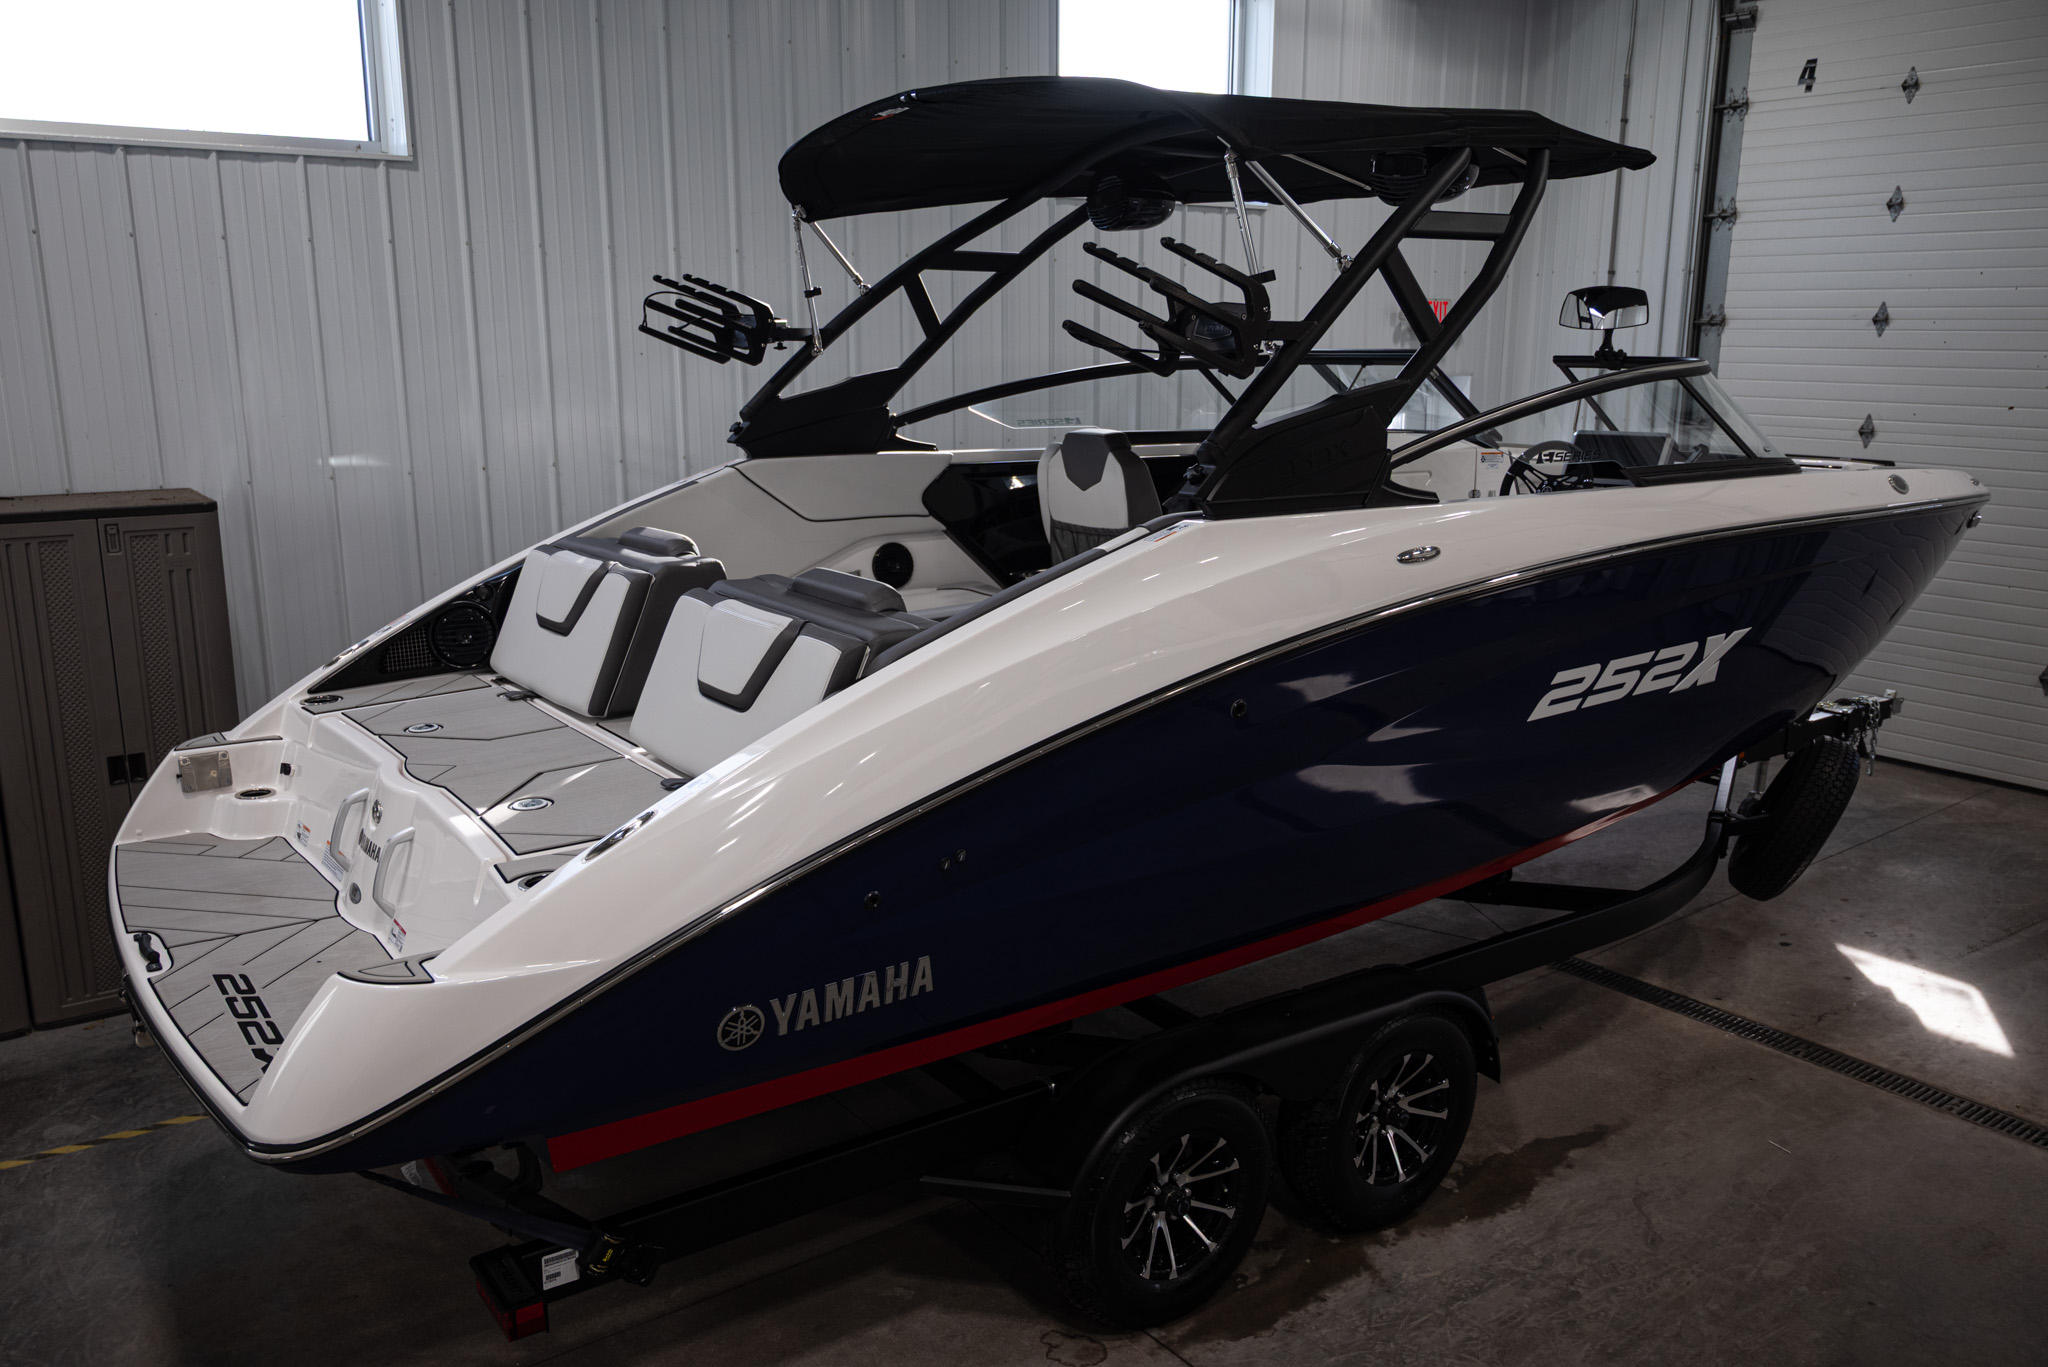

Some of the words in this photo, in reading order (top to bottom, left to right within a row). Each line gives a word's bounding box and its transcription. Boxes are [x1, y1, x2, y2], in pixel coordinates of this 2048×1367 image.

[1797, 58, 1818, 93] 4
[1428, 301, 1449, 324] XIT
[1554, 449, 1601, 463] SERIES
[1527, 626, 1753, 722] 252X
[769, 954, 934, 1037] YAMAHA
